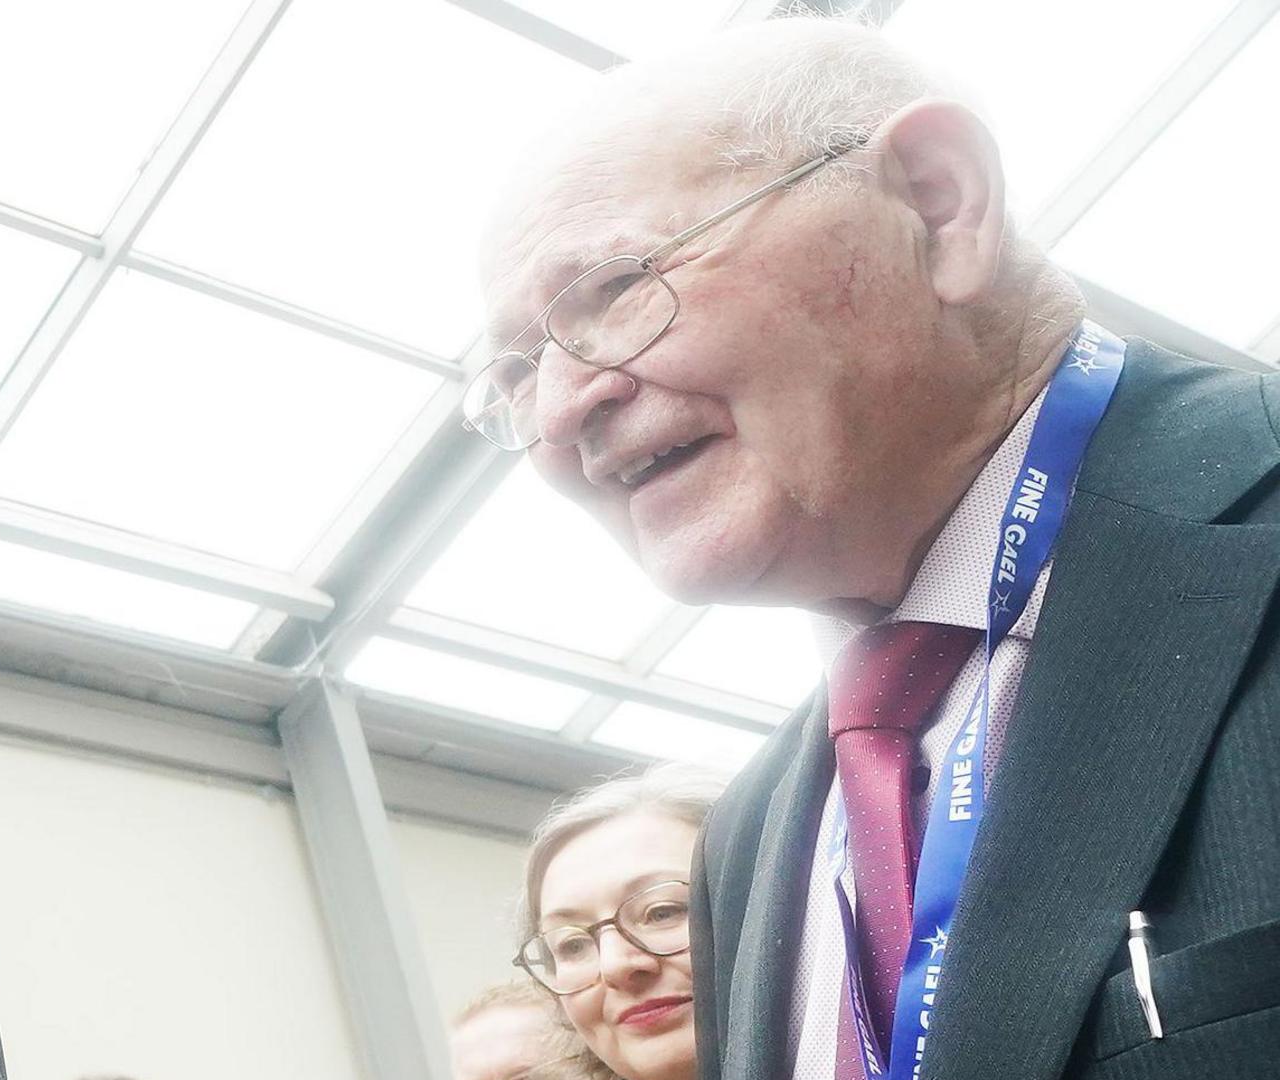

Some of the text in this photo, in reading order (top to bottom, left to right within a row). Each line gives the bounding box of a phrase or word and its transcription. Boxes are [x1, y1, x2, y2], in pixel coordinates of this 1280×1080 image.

[997, 467, 1048, 584] FINE GAEL
[949, 759, 972, 822] FINE
